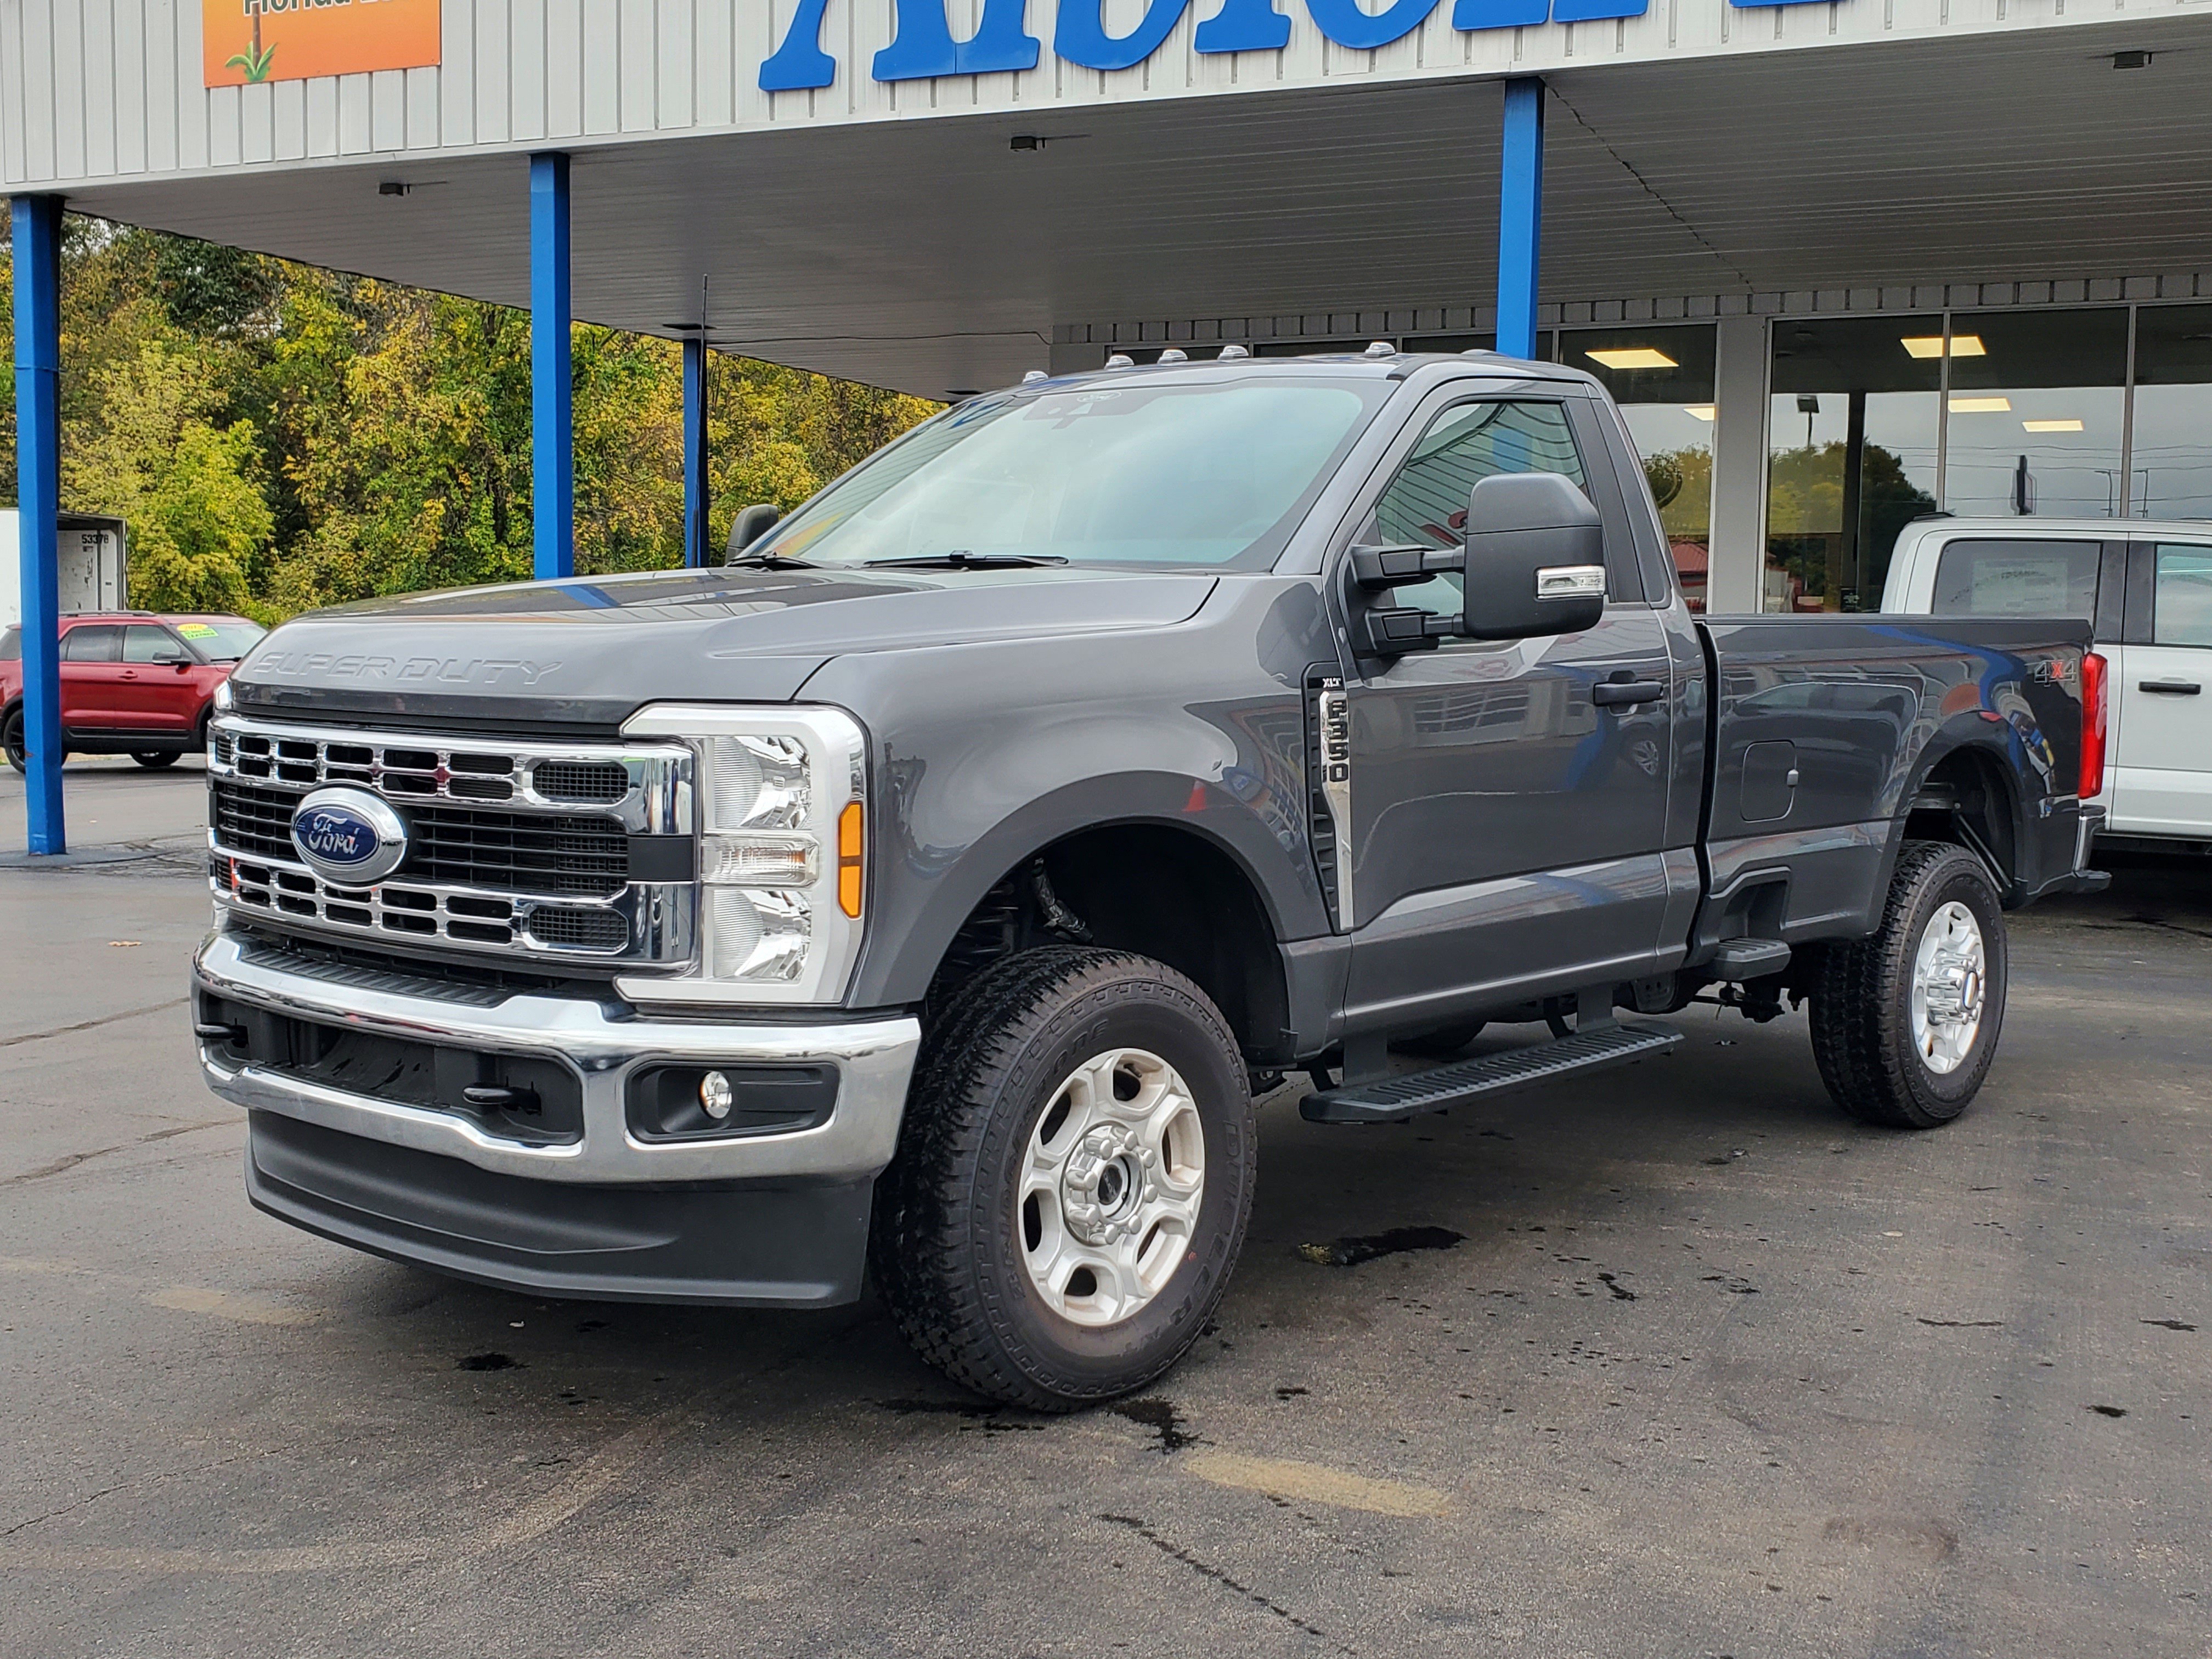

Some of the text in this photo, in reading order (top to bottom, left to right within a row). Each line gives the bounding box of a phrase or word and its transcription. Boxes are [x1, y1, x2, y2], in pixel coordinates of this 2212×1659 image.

[253, 651, 563, 685] SUPER DUTY
[1322, 678, 1341, 688] XLT
[308, 813, 359, 854] Ford
